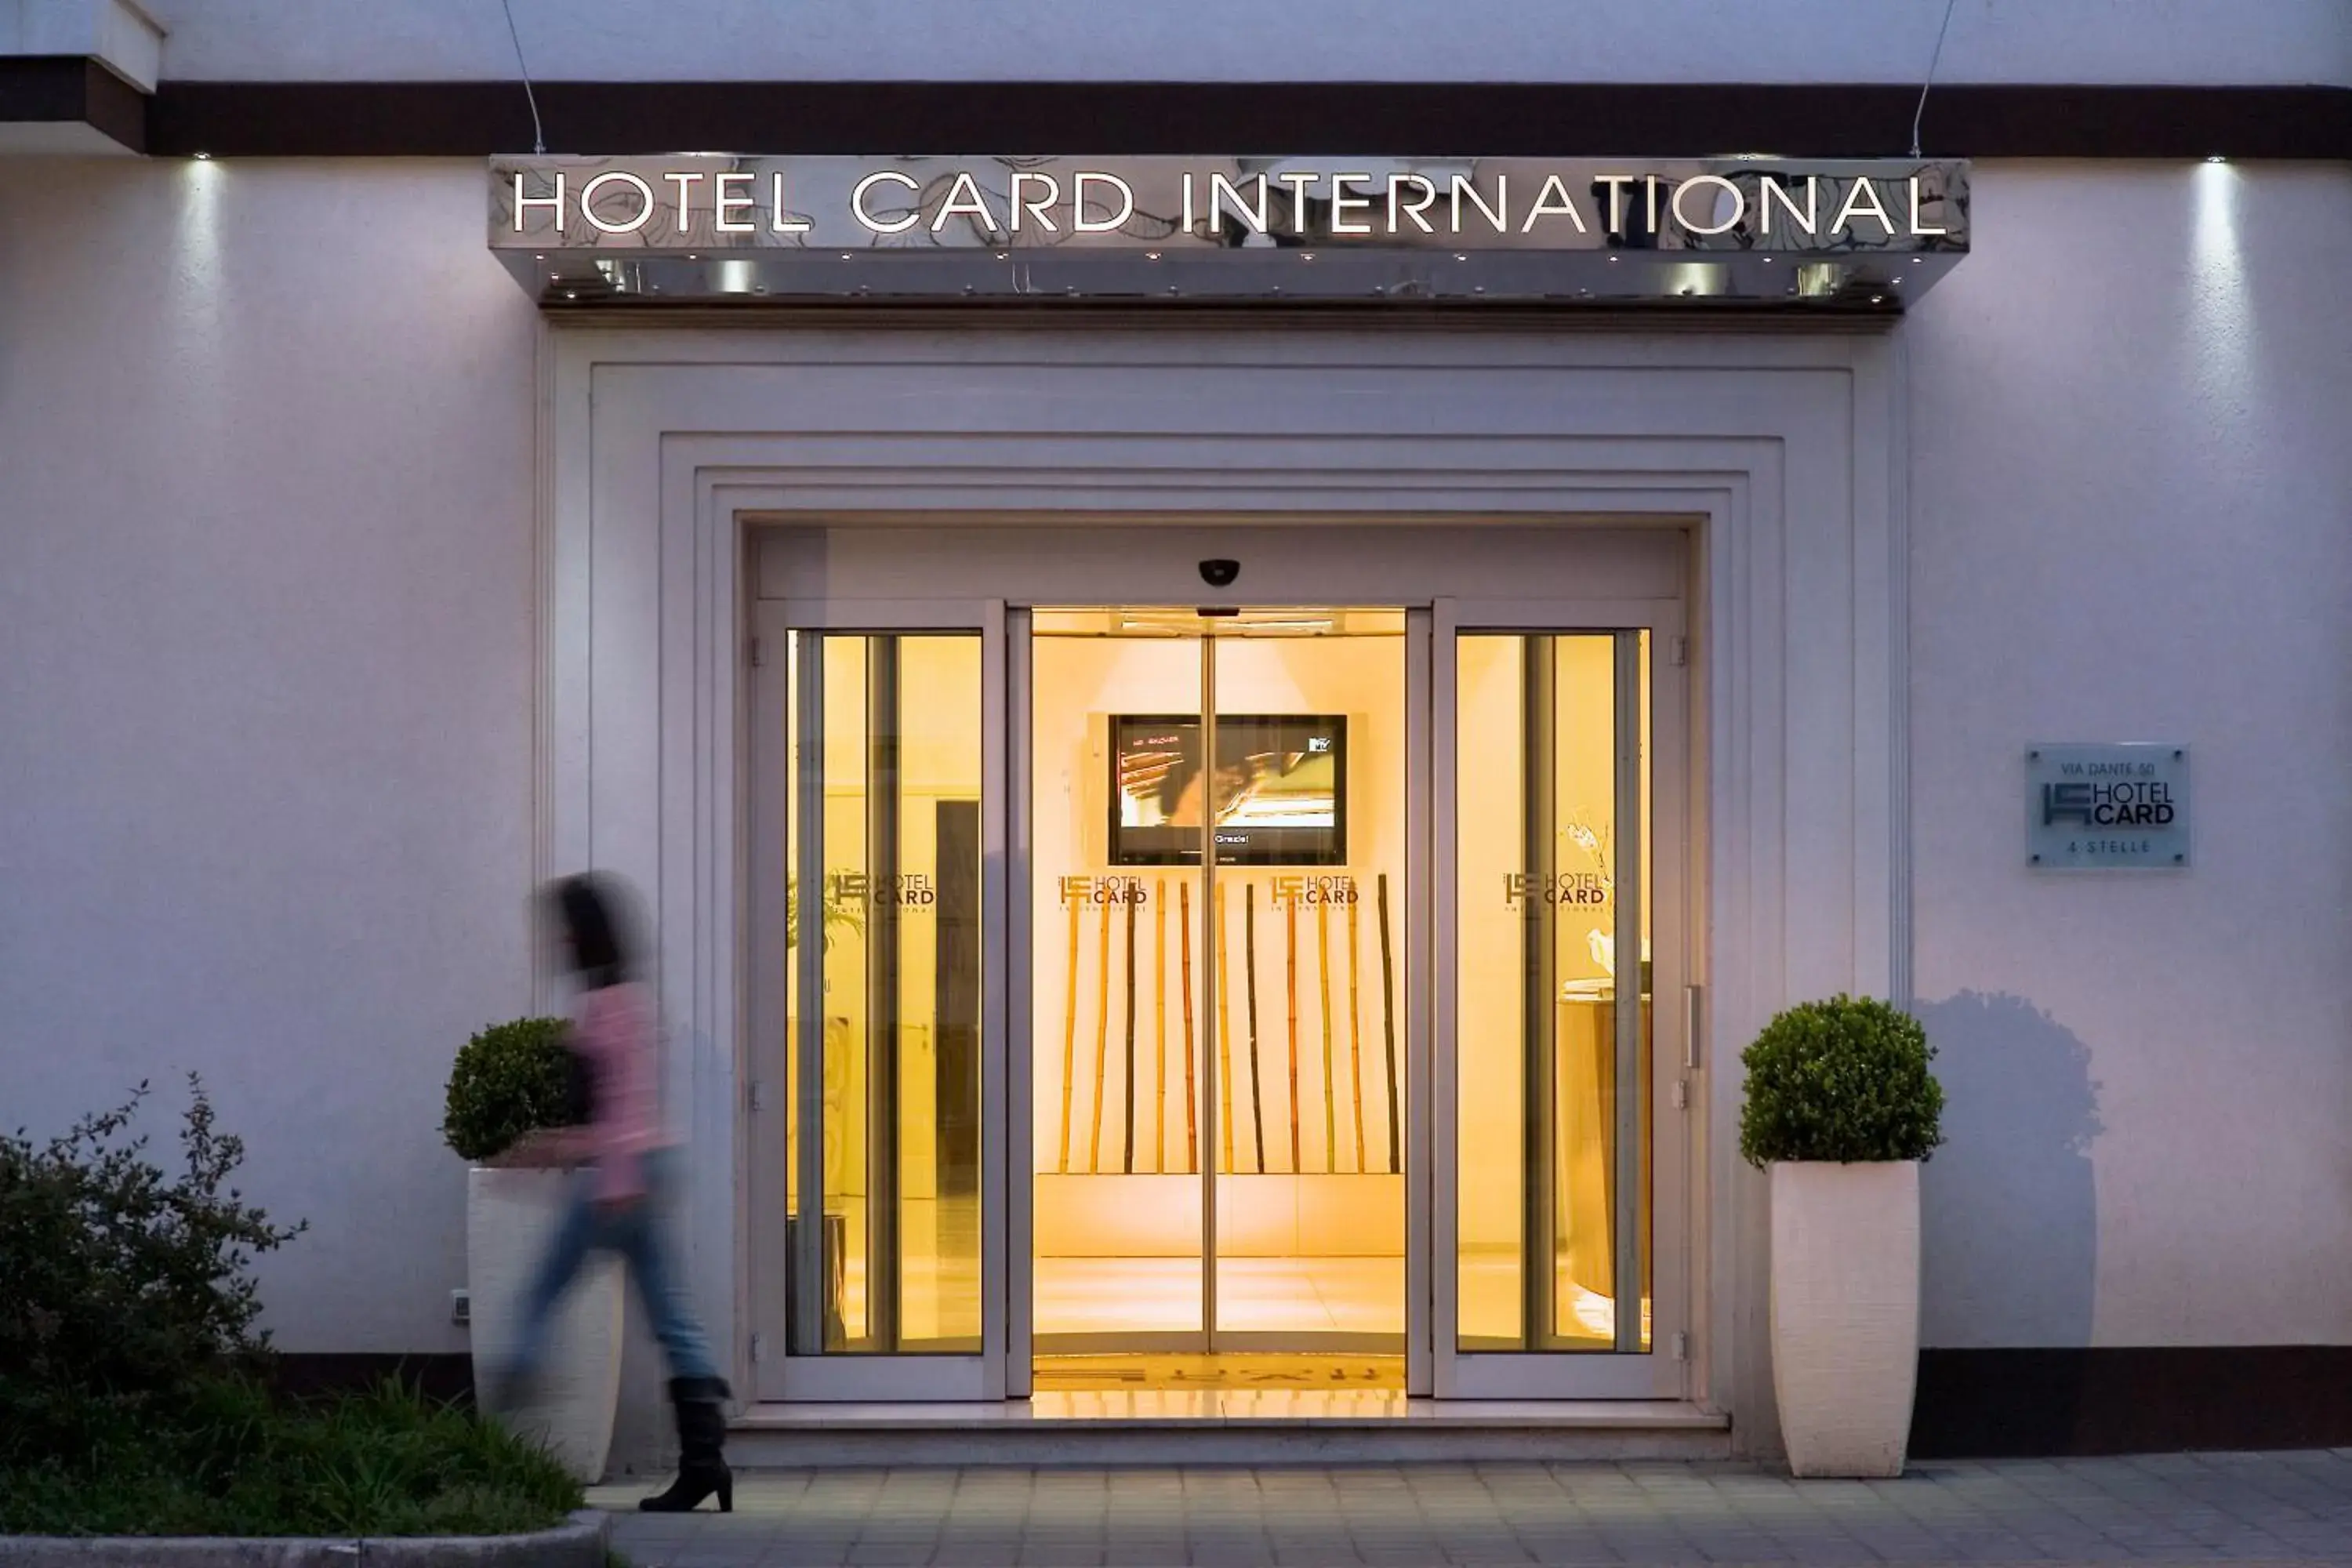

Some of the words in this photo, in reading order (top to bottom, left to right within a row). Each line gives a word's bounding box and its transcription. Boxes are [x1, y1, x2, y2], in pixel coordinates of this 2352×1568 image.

[514, 170, 811, 234] HOTEL
[849, 170, 1134, 234] CARD
[1181, 171, 1947, 236] INTERNATIONAL
[2061, 763, 2083, 775] VIA
[2094, 782, 2174, 804] HOTEL
[2094, 804, 2174, 826] CARD
[2067, 841, 2076, 853] 4
[2087, 840, 2151, 854] STELLE
[1094, 876, 1146, 891] HOTEL
[1307, 876, 1357, 891] HOTEL
[1545, 873, 1603, 890] HOTEL
[1306, 890, 1359, 904] CARD
[1544, 889, 1605, 904] CARD
